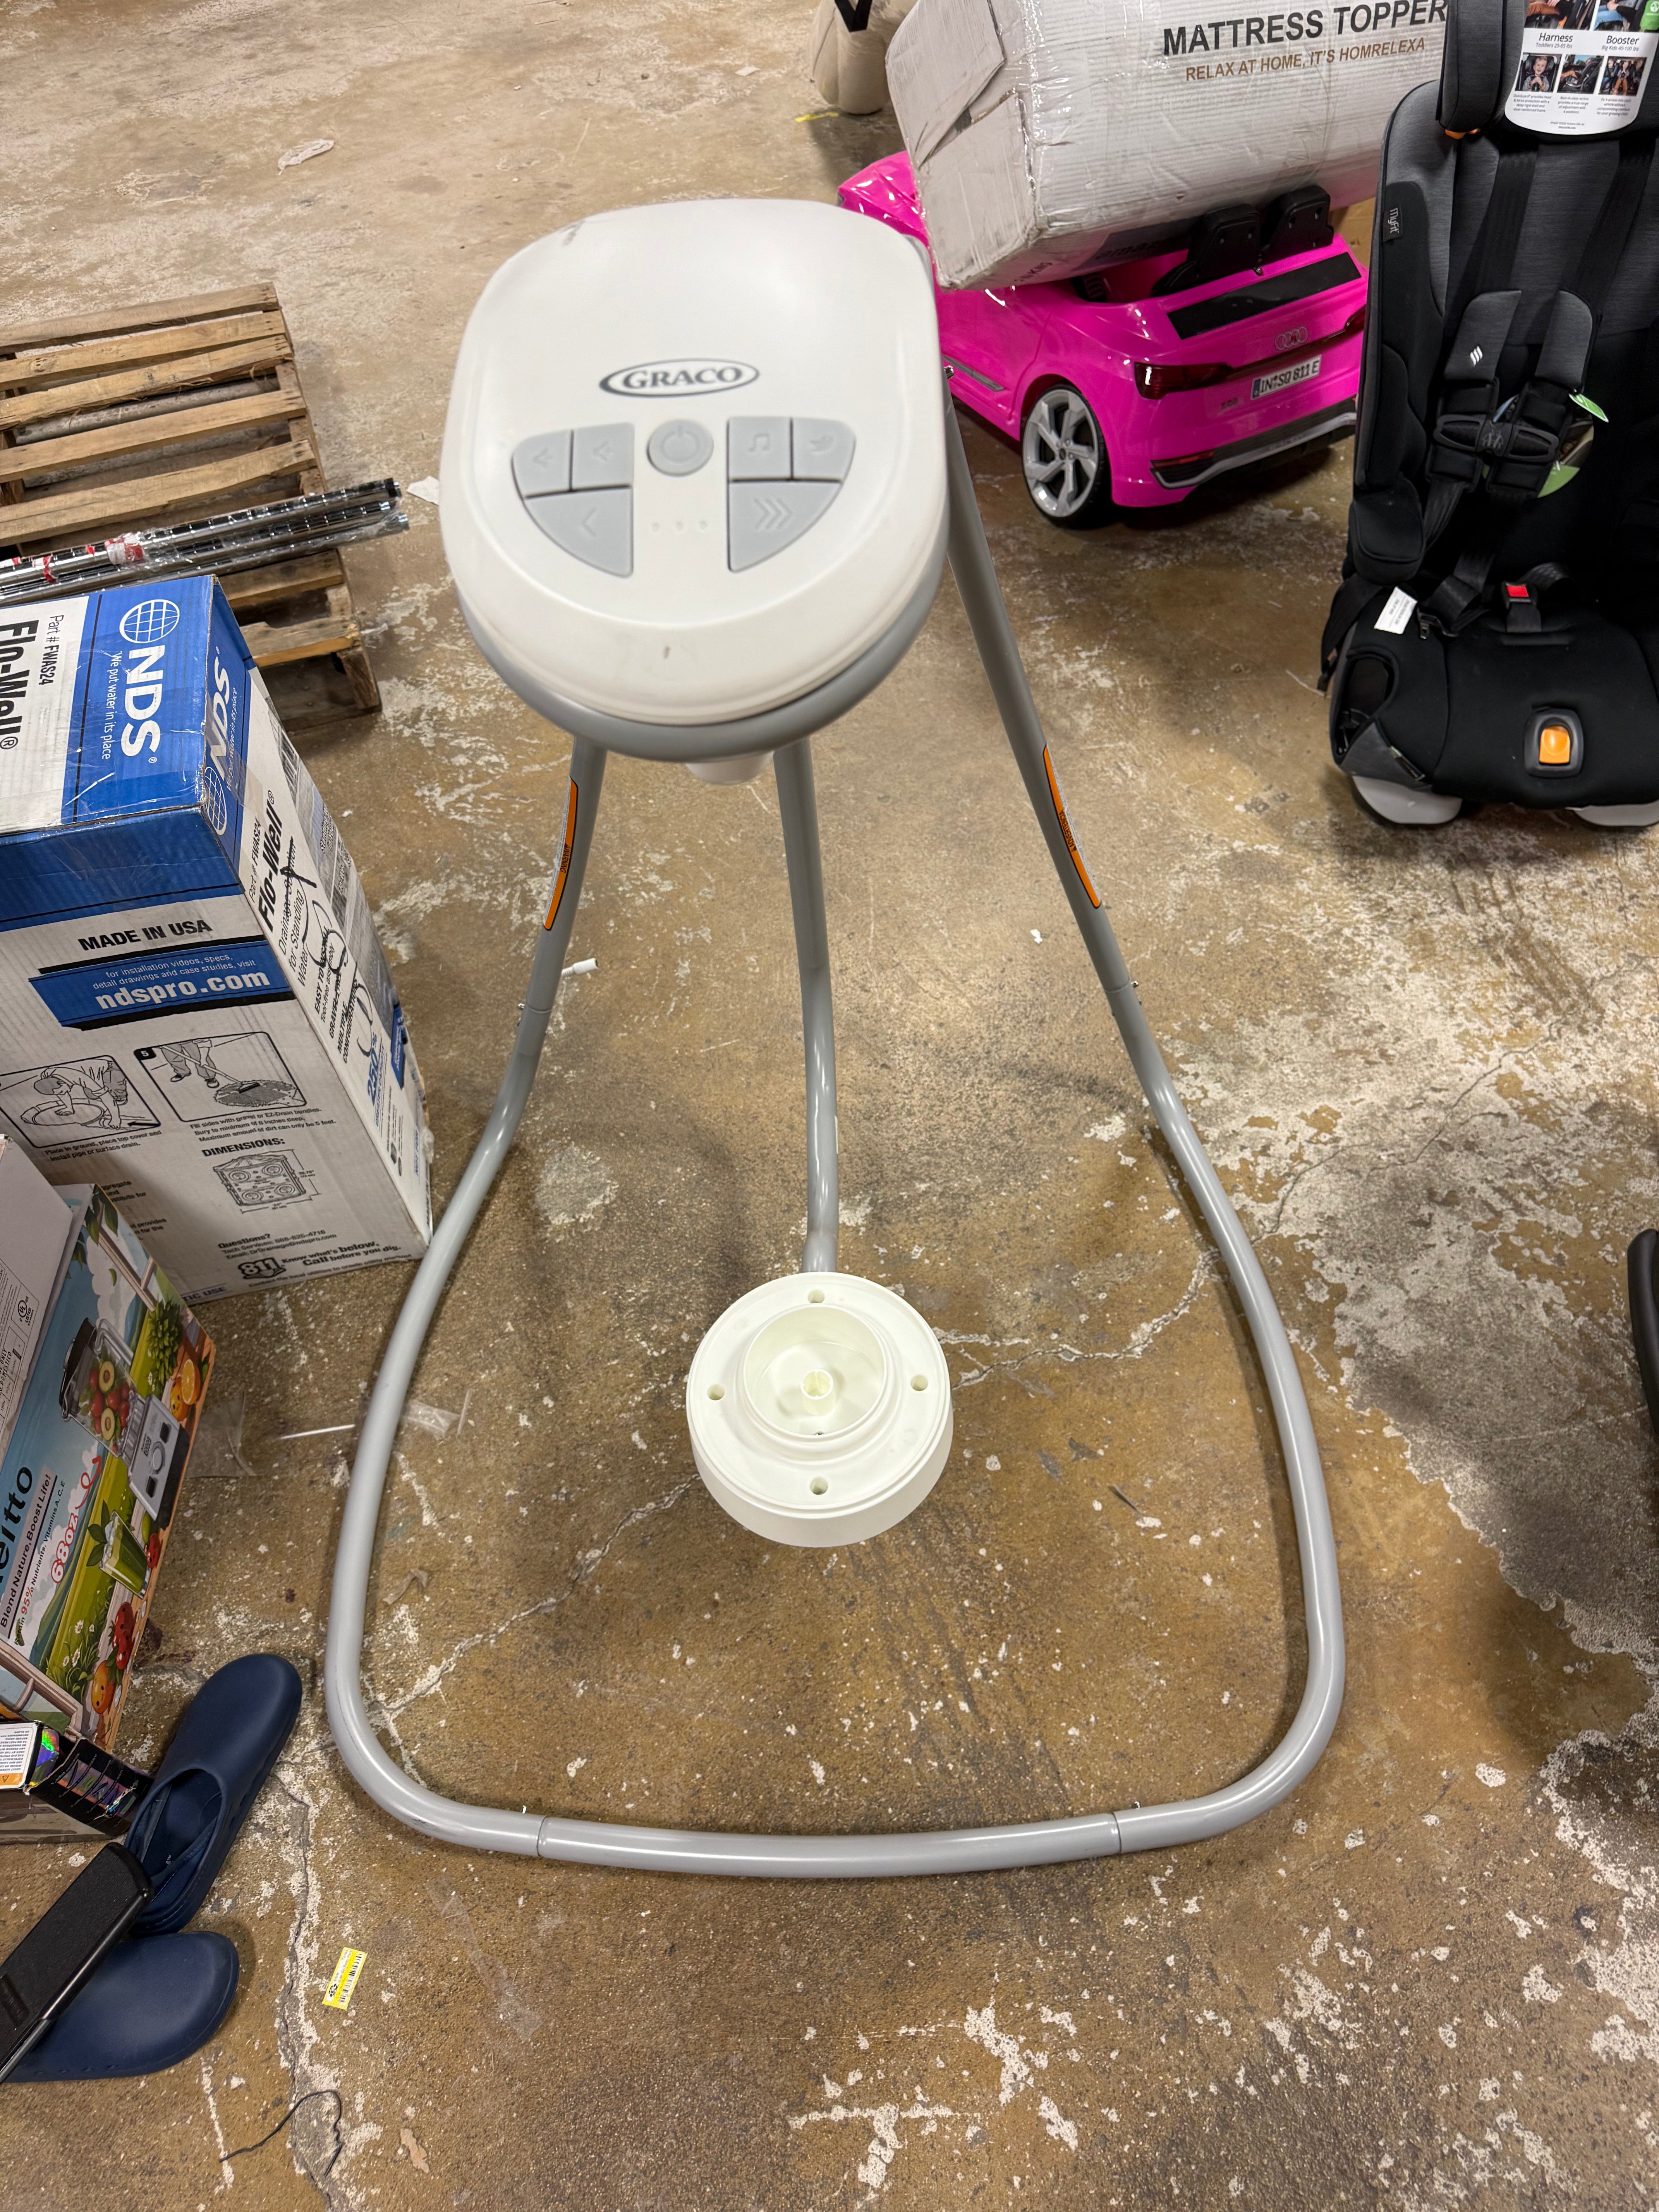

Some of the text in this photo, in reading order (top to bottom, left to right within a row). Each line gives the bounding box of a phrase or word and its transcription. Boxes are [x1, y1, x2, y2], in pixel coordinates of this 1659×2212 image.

[1163, 0, 1448, 56] MATTRESS TOPPER
[1539, 33, 1573, 43] Harness
[1606, 35, 1639, 45] Booster
[1186, 37, 1425, 81] RELAX AT HOME, IT'S HOMRELEXA
[623, 366, 743, 389] GRACO
[47, 614, 64, 635] Part
[38, 644, 60, 686] FWAS24
[101, 651, 123, 760] We put water in its place
[252, 816, 261, 867] FWAS24
[78, 919, 213, 951] MADE IN USA
[289, 889, 304, 972] for Standing
[93, 959, 256, 989] detail drawings and case studies, visit
[106, 953, 233, 979] for installation videos, specs,
[297, 948, 309, 987] Water
[318, 967, 325, 982] TO
[95, 971, 270, 1010] ndspro.com
[314, 982, 323, 1015] EASY
[337, 1000, 348, 1054] MULTIPLE
[141, 1050, 149, 1058] 5
[98, 1138, 117, 1146] place
[194, 1128, 210, 1137] Bury
[219, 1123, 250, 1132] minimum
[199, 1133, 231, 1142] Maximum
[232, 1128, 257, 1136] amount
[95, 1145, 121, 1153] surface
[202, 1137, 286, 1157] DIMENSIONS:
[302, 1256, 330, 1266] Call
[330, 1251, 361, 1261] before
[362, 1247, 381, 1255] you
[338, 1241, 380, 1253] below.
[237, 1257, 280, 1277] 811
[0, 1588, 17, 1630] Blend
[38, 1473, 52, 1501] Life!
[21, 1585, 34, 1616] 95%
[43, 1506, 58, 1543] Vitamins
[51, 1512, 79, 1584] 68oz
